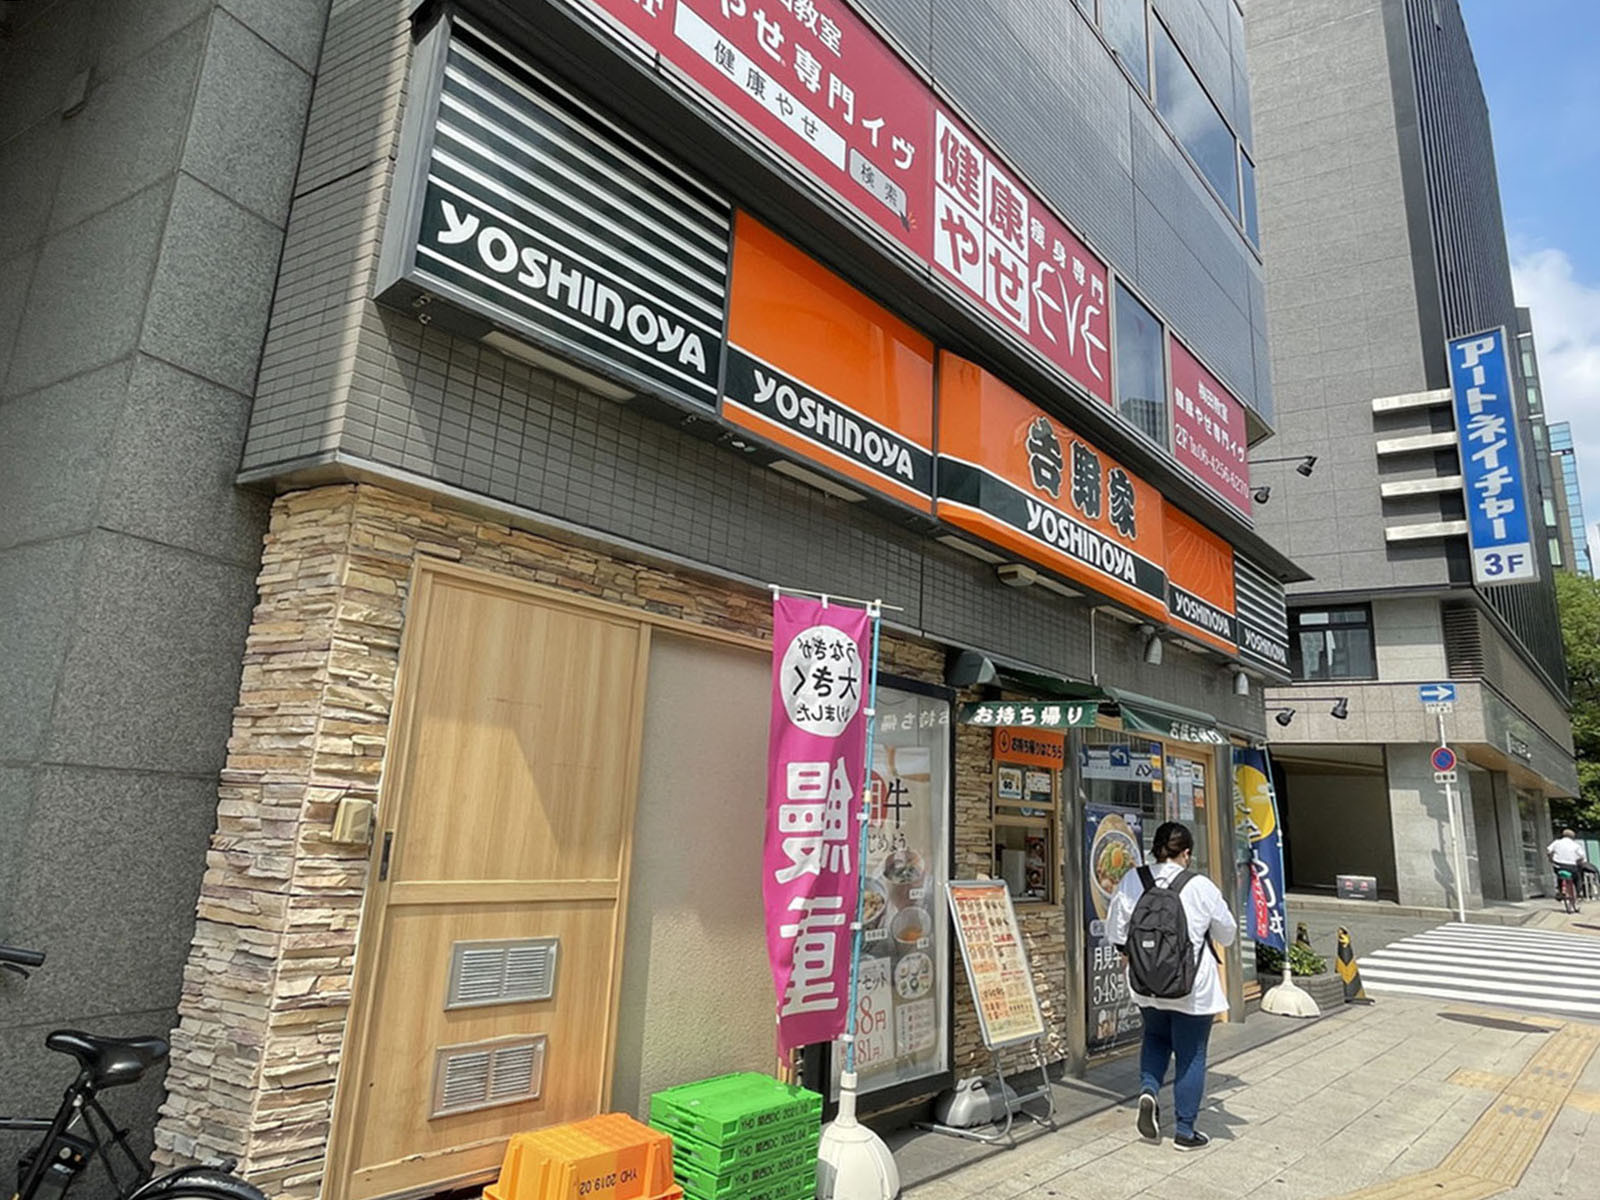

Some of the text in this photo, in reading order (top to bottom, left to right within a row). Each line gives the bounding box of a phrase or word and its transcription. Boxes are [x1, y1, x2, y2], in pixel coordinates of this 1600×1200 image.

[780, 0, 843, 58] 教室
[714, 39, 820, 142] 健康やせ
[859, 161, 900, 208] 検索
[938, 125, 1026, 255] 健康
[437, 199, 706, 374] YOSHINOYA
[940, 204, 1026, 328] やせ
[752, 369, 914, 481] YOSHINOYA
[1456, 335, 1515, 540] アートネイチャー
[1026, 416, 1137, 541] 吉野家
[1026, 498, 1137, 585] YOSHINOYA
[1484, 553, 1524, 577] 3F
[1175, 591, 1231, 638] YOSHINOYA
[1244, 627, 1287, 665] YOSHINOYA
[974, 705, 1084, 725] お持ち帰り
